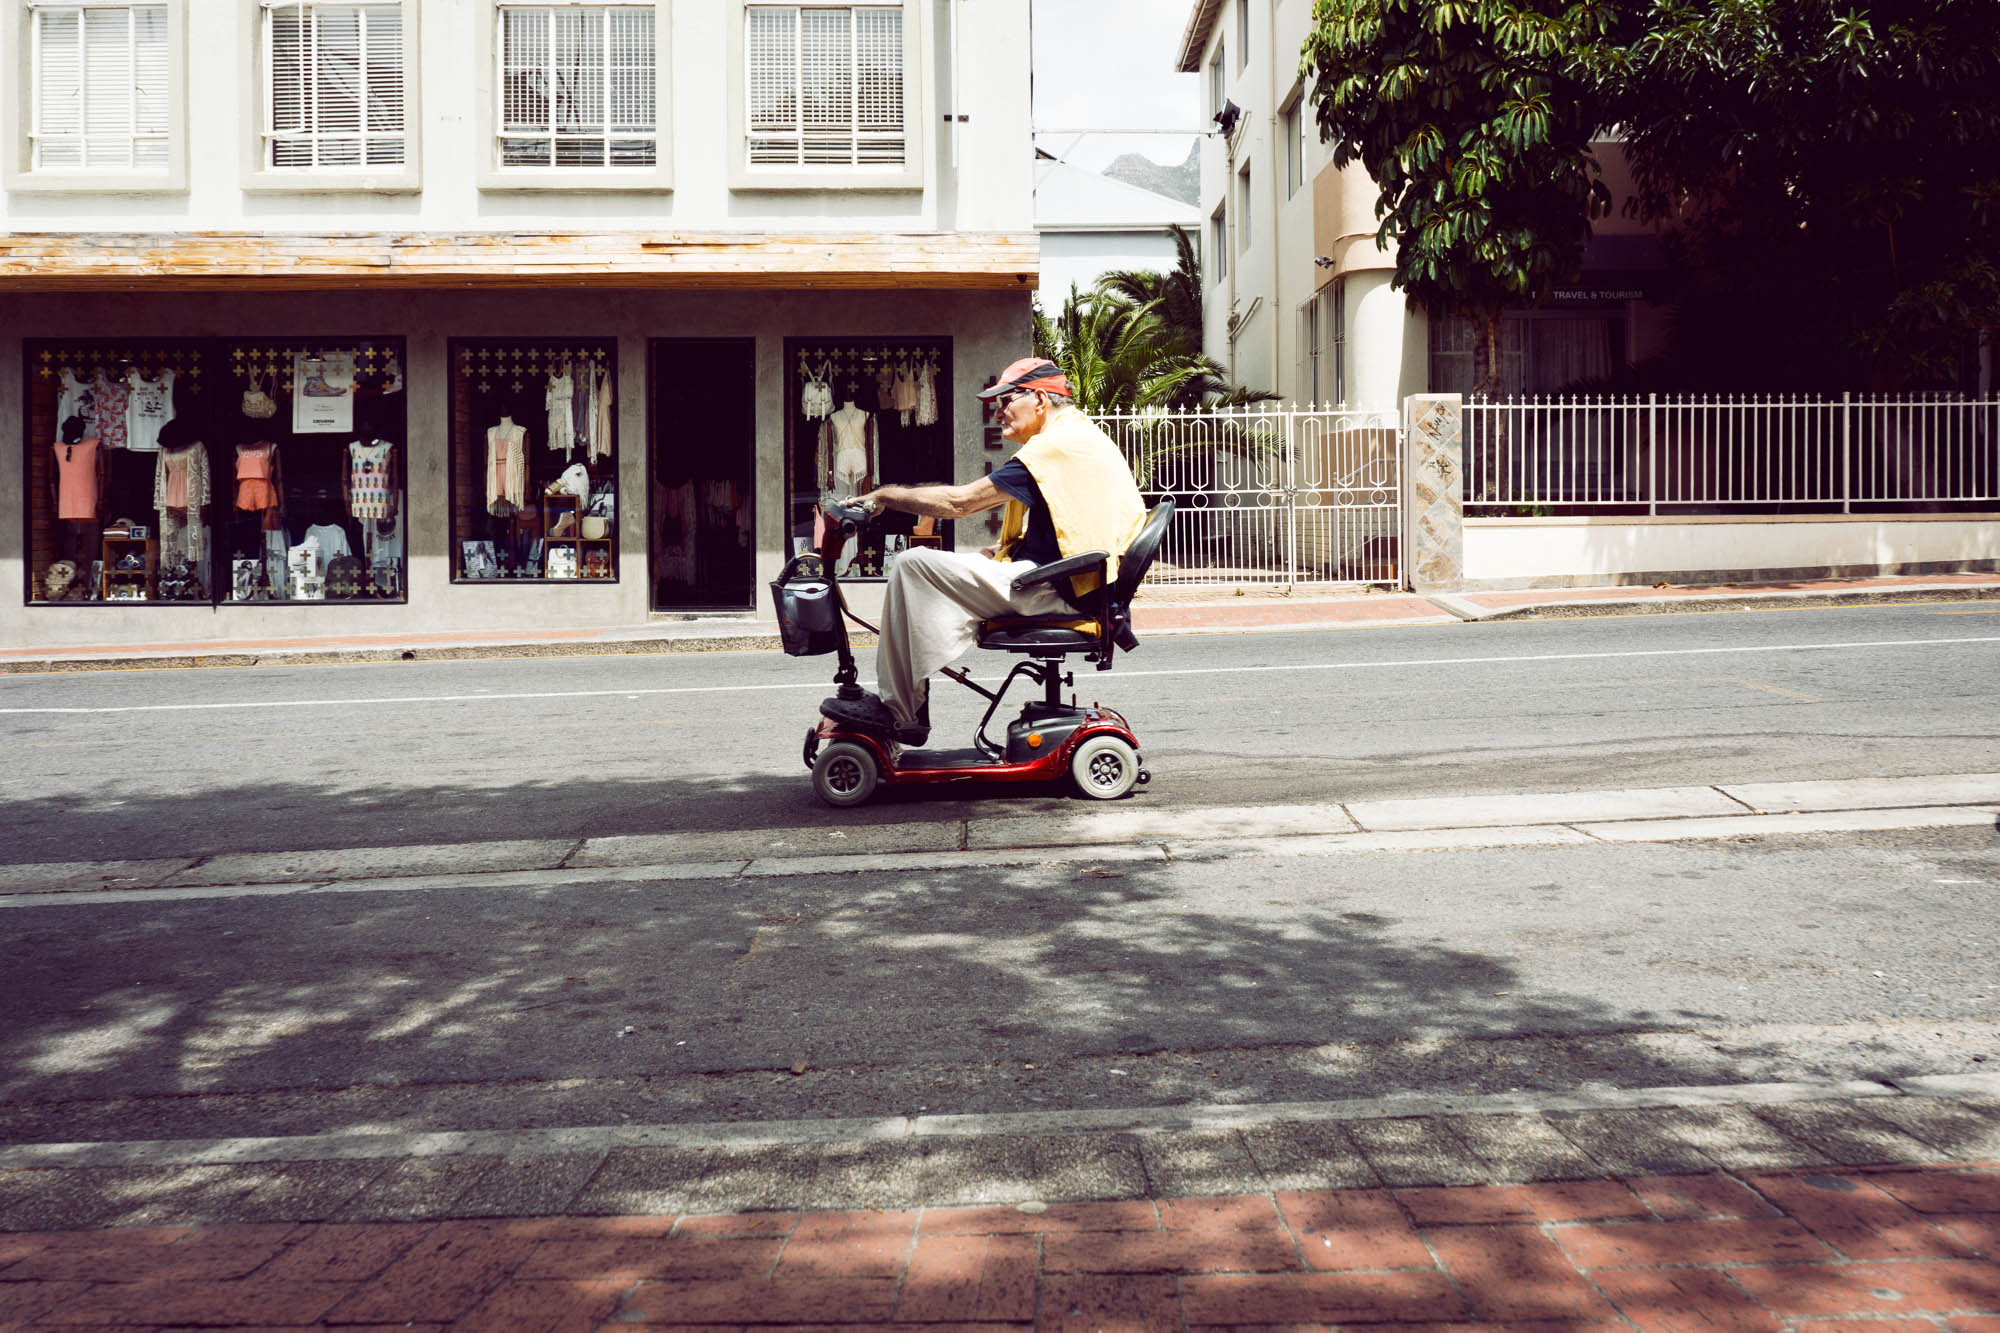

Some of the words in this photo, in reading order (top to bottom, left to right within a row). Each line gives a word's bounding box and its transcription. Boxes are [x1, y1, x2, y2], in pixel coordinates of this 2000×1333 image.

[1553, 291, 1588, 299] TRAVEL
[1590, 291, 1598, 299] &
[1600, 291, 1643, 299] TOURISM
